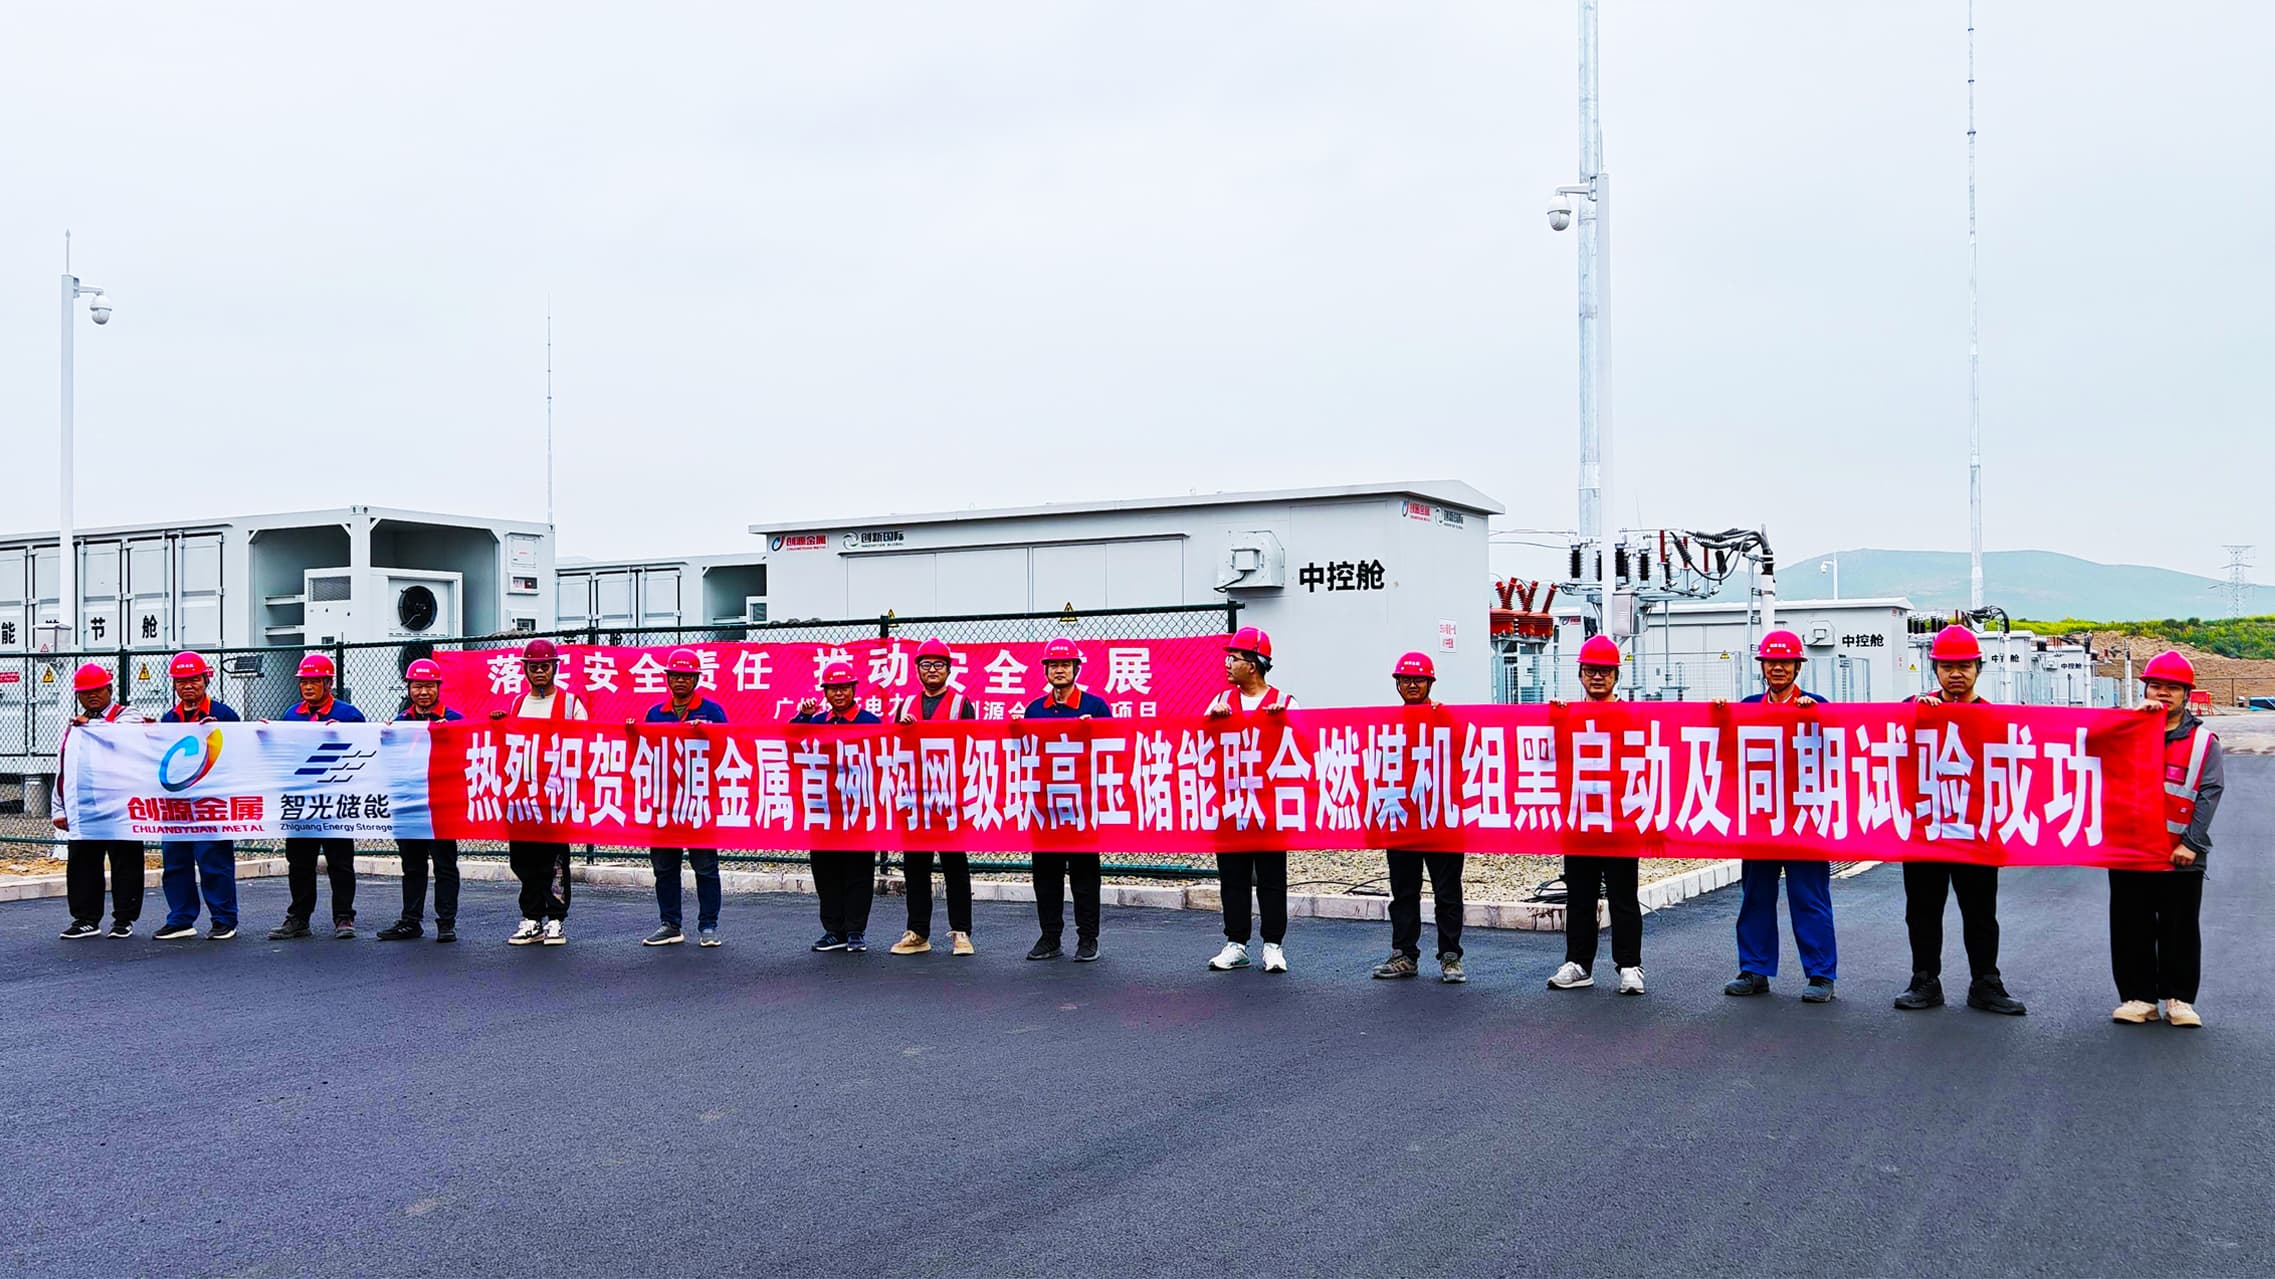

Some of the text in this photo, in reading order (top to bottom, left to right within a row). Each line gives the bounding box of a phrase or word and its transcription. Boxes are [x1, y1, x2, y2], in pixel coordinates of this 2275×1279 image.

[1299, 559, 1386, 593] 中控舱
[1841, 633, 1885, 648] 中控舱
[464, 720, 2103, 848] 热烈祝贺创源金属首例构网级联高压储能联合燃煤机组黑启动及同期试验成功
[128, 796, 264, 822] 创源金属
[280, 793, 392, 821] 智光储能
[222, 824, 265, 833] METAL
[280, 822, 393, 833] Zhiguang Energy Storage
